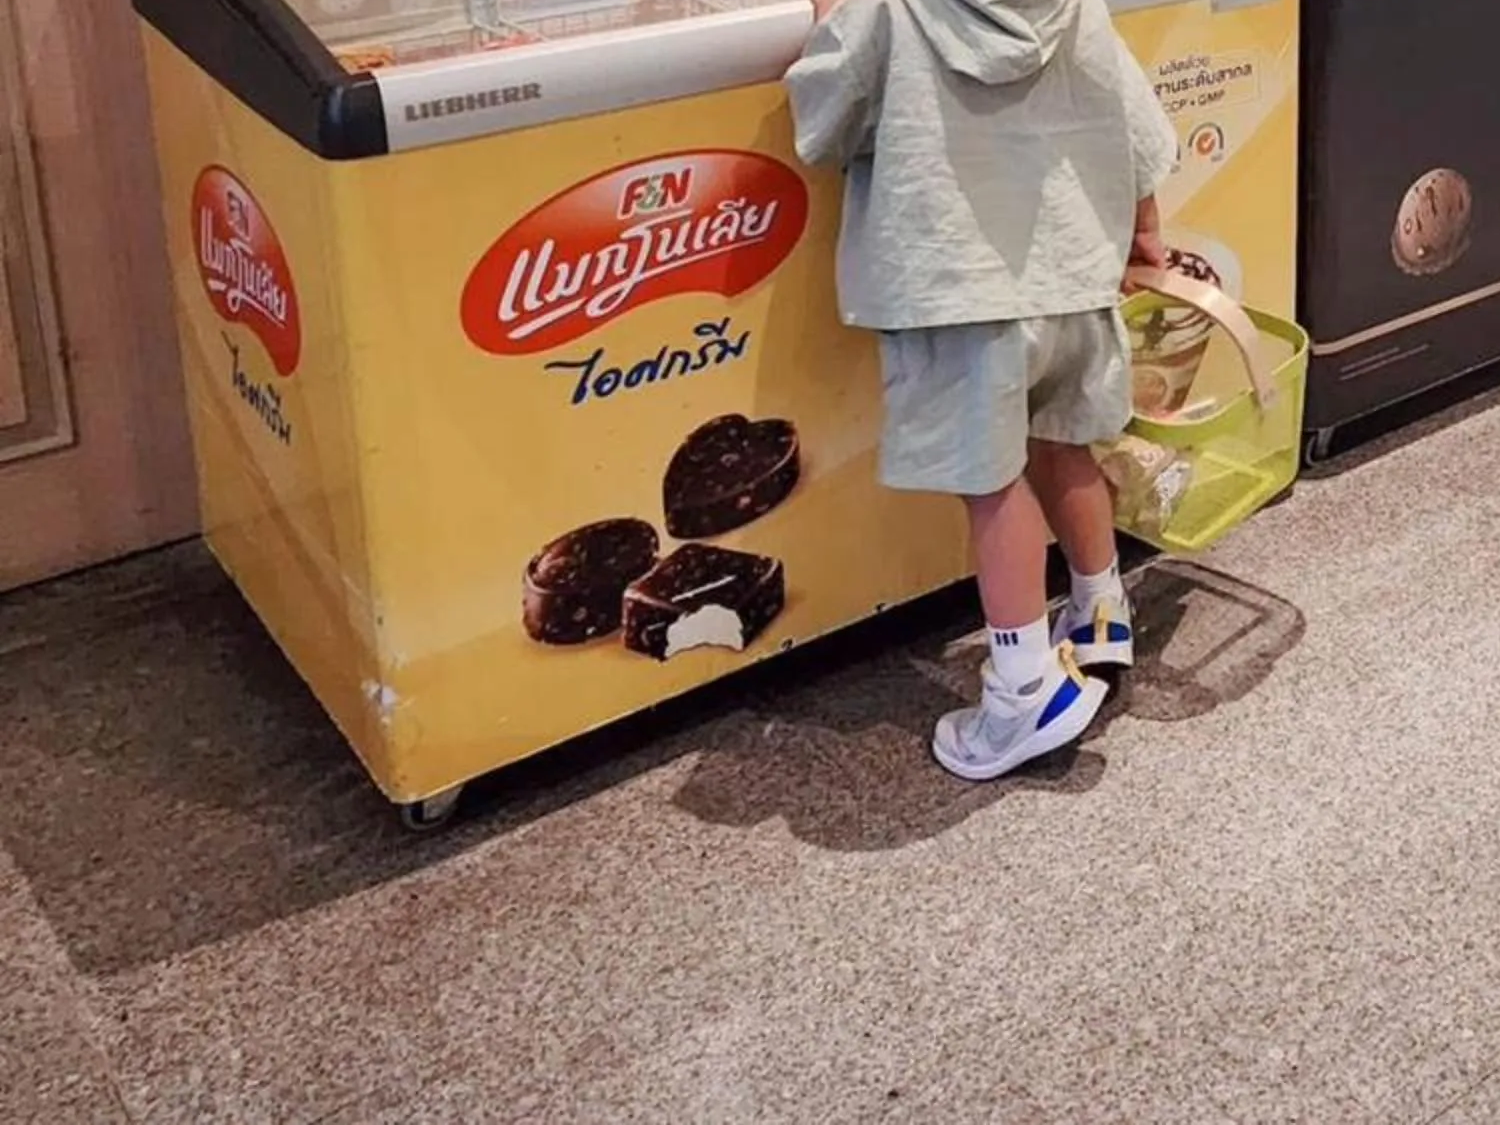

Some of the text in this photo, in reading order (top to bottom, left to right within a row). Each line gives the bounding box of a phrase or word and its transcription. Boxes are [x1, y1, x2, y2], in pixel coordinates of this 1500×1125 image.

[405, 82, 542, 122] LIEBHERR
[618, 167, 693, 217] F&N
[498, 197, 779, 322] แมกโนเลีย
[220, 329, 292, 447] ไอศกรีม
[544, 316, 752, 405] ไอศกรีม
